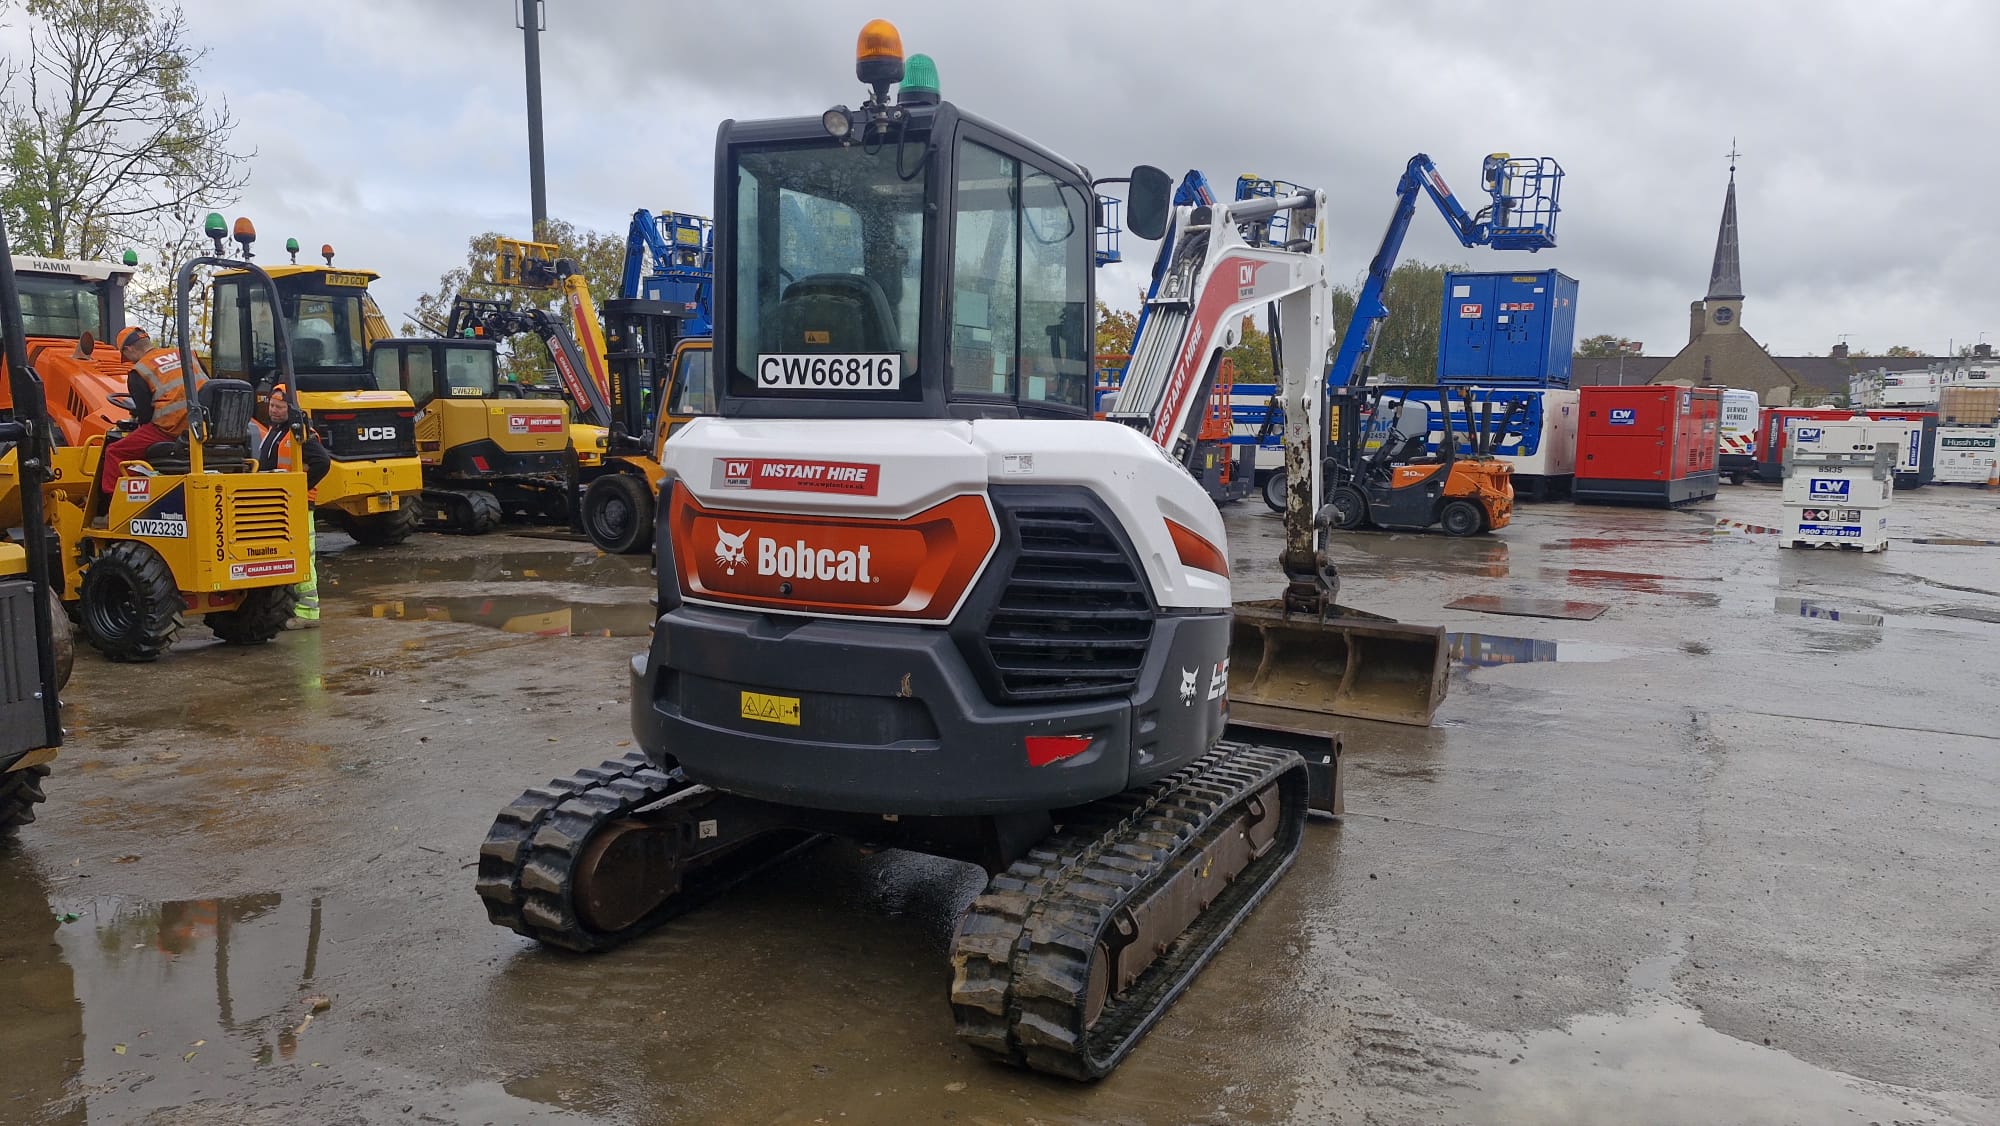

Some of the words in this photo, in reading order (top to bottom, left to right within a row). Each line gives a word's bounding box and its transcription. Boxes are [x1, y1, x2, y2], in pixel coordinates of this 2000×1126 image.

[33, 261, 72, 273] HAMM
[1240, 264, 1254, 285] CW
[154, 352, 179, 365] CW
[760, 357, 894, 387] CW66816
[614, 372, 623, 405] SAMUK
[1157, 366, 1187, 445] INSTANT
[1184, 319, 1203, 365] HIRE
[1612, 410, 1632, 419] CW
[511, 417, 526, 426] CW
[357, 427, 396, 441] JCB
[1799, 429, 1818, 437] CW
[728, 462, 748, 477] CW
[761, 463, 825, 480] INSTANT
[827, 467, 868, 482] HIRE
[130, 480, 147, 493] CW
[1815, 480, 1844, 493] CW
[131, 520, 184, 537] CW23239
[1799, 528, 1821, 536] 0800
[246, 547, 278, 557] Thwaites
[757, 537, 871, 583] Bobcat
[248, 565, 273, 573] CHARLES
